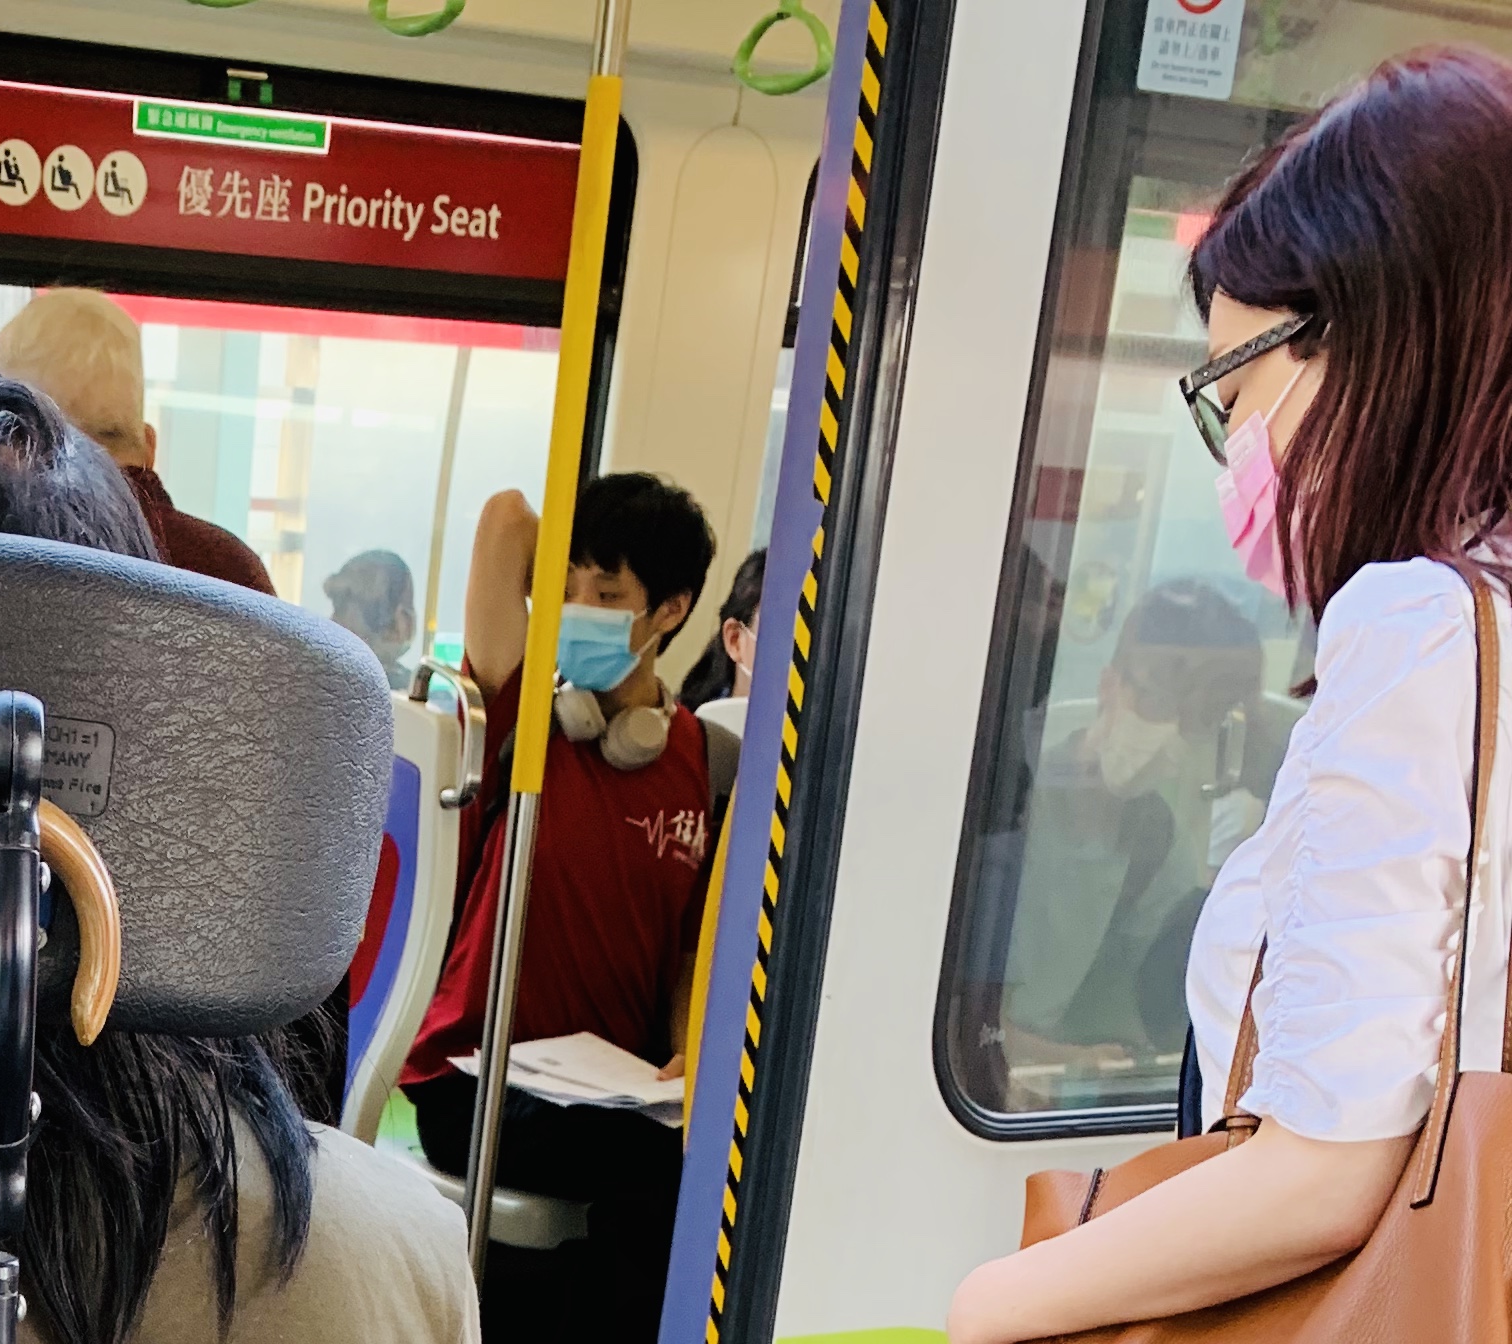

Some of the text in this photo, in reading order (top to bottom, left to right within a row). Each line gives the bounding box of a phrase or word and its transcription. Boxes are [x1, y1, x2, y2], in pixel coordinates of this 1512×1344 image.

[178, 165, 502, 242] 優先座 Priority Seat
